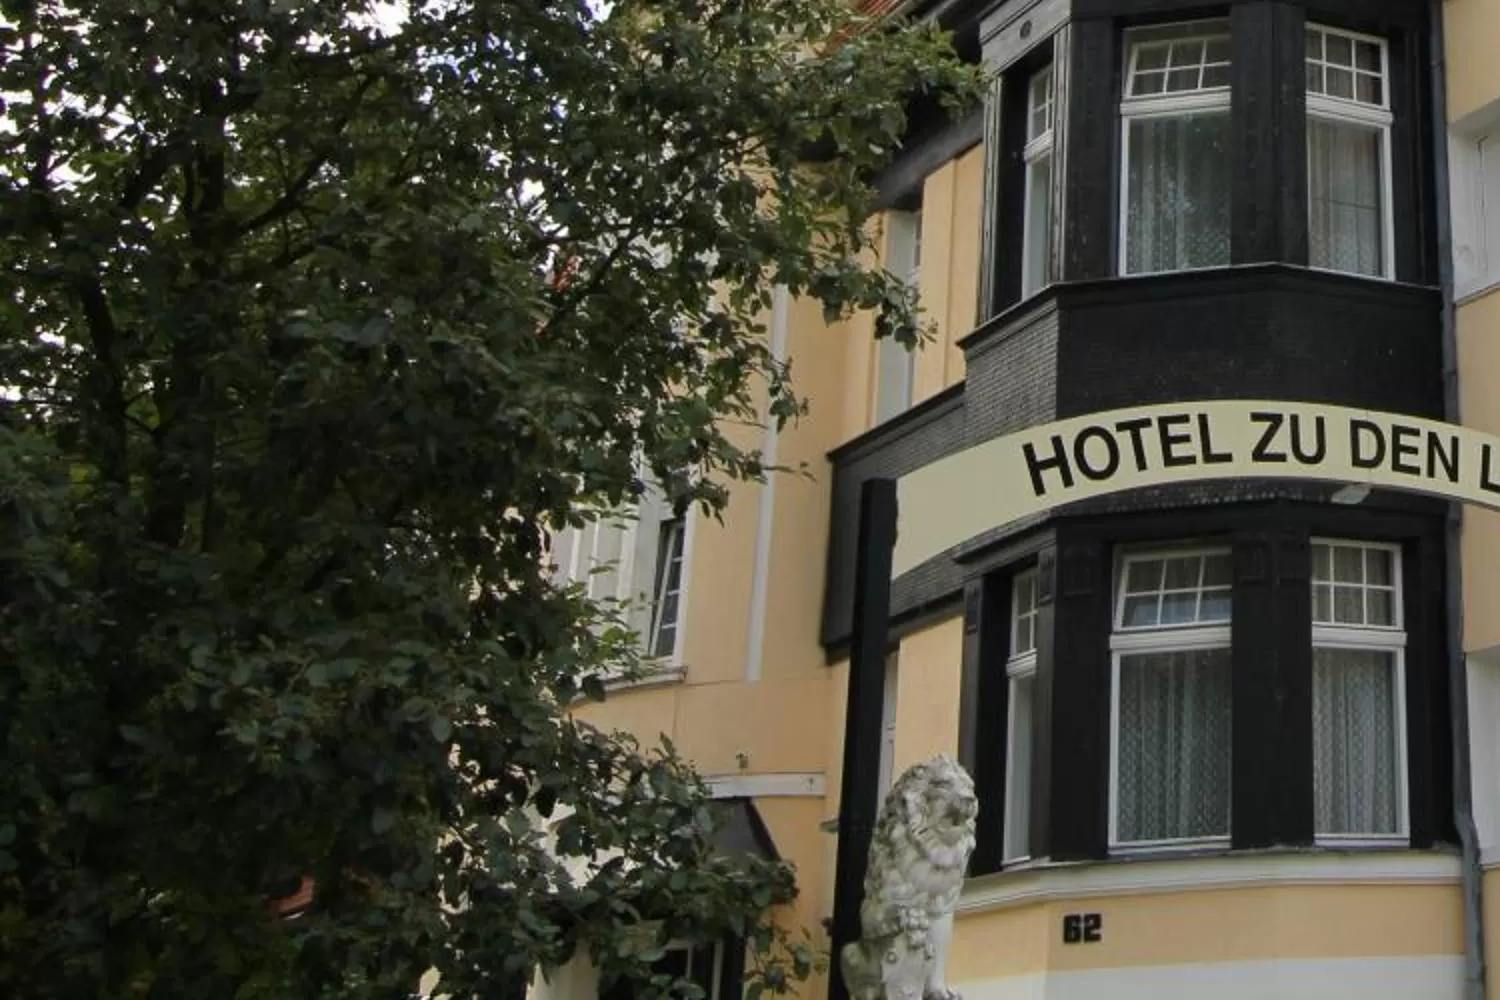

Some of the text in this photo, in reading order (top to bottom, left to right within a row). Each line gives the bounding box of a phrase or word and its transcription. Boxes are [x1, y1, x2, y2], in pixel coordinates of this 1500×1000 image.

[1022, 413, 1233, 497] HOTEL
[1250, 412, 1326, 465] ZU
[1349, 419, 1460, 484] DEN
[1063, 913, 1103, 943] 62
